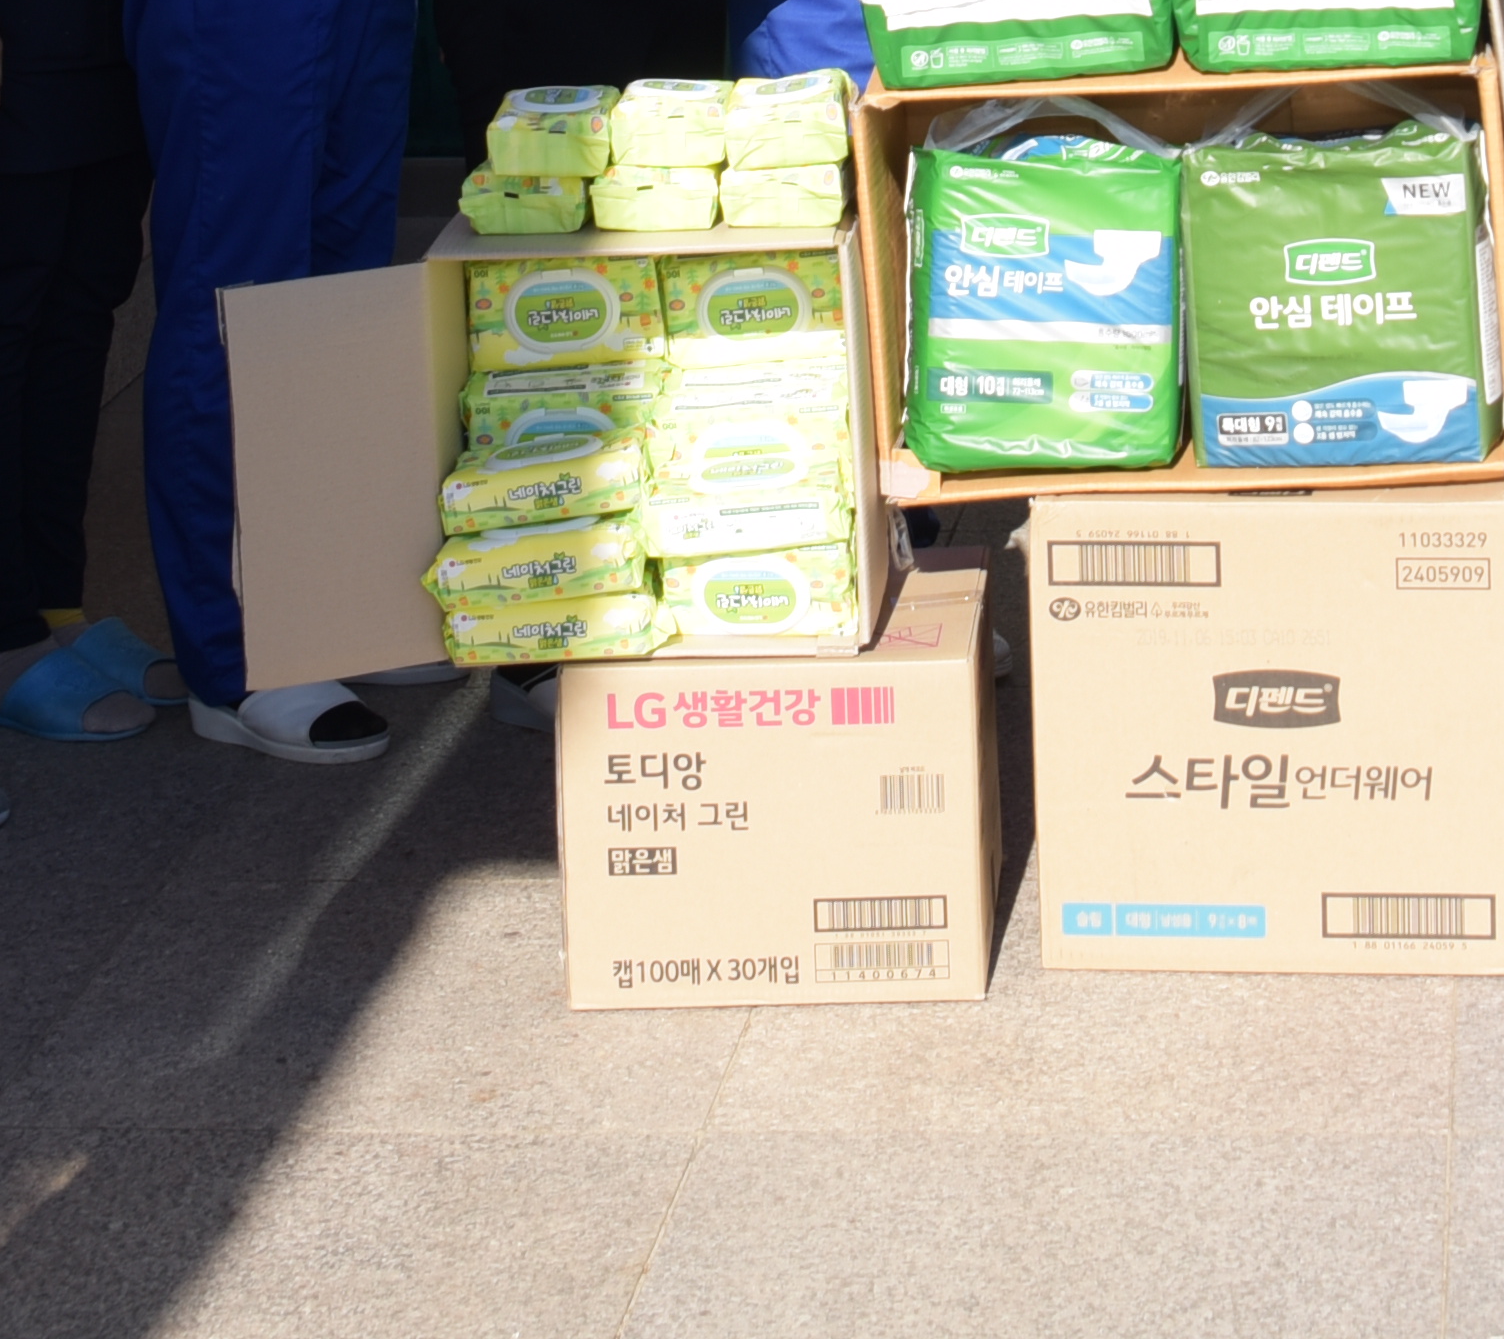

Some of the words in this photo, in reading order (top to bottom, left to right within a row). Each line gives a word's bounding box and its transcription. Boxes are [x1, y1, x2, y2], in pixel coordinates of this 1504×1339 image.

[1402, 181, 1452, 199] NEW
[971, 227, 1038, 247] 디펜드
[473, 267, 489, 279] 100
[1295, 251, 1364, 276] 디펜드
[945, 265, 1000, 298] 안심
[1003, 271, 1064, 294] 테이프
[527, 305, 599, 326] 네이처그린
[718, 304, 791, 326] 네이처그린
[1249, 294, 1312, 330] 안심
[1320, 291, 1418, 326] 테이프
[940, 376, 968, 397] 대형
[507, 477, 582, 501] 네이처그린
[1398, 531, 1488, 549] 11033329
[501, 556, 577, 579] 네이처그린
[1401, 565, 1485, 583] 2405909
[715, 593, 789, 609] 네이처그린
[1084, 599, 1148, 619] 유한킴벌리
[512, 621, 588, 639] 네이처그린
[673, 688, 821, 729] 생활건강
[1224, 684, 1327, 717] 디펜드
[603, 751, 707, 791] 토디앙
[1124, 753, 1291, 810] 스타일
[1294, 764, 1434, 802] 언더웨어
[607, 802, 687, 832] 네이처
[697, 800, 750, 831] 그린
[611, 848, 673, 874] 맑은샘
[612, 958, 701, 989] 캡100매
[727, 956, 800, 985] 30개입
[831, 967, 937, 982] 11400674
